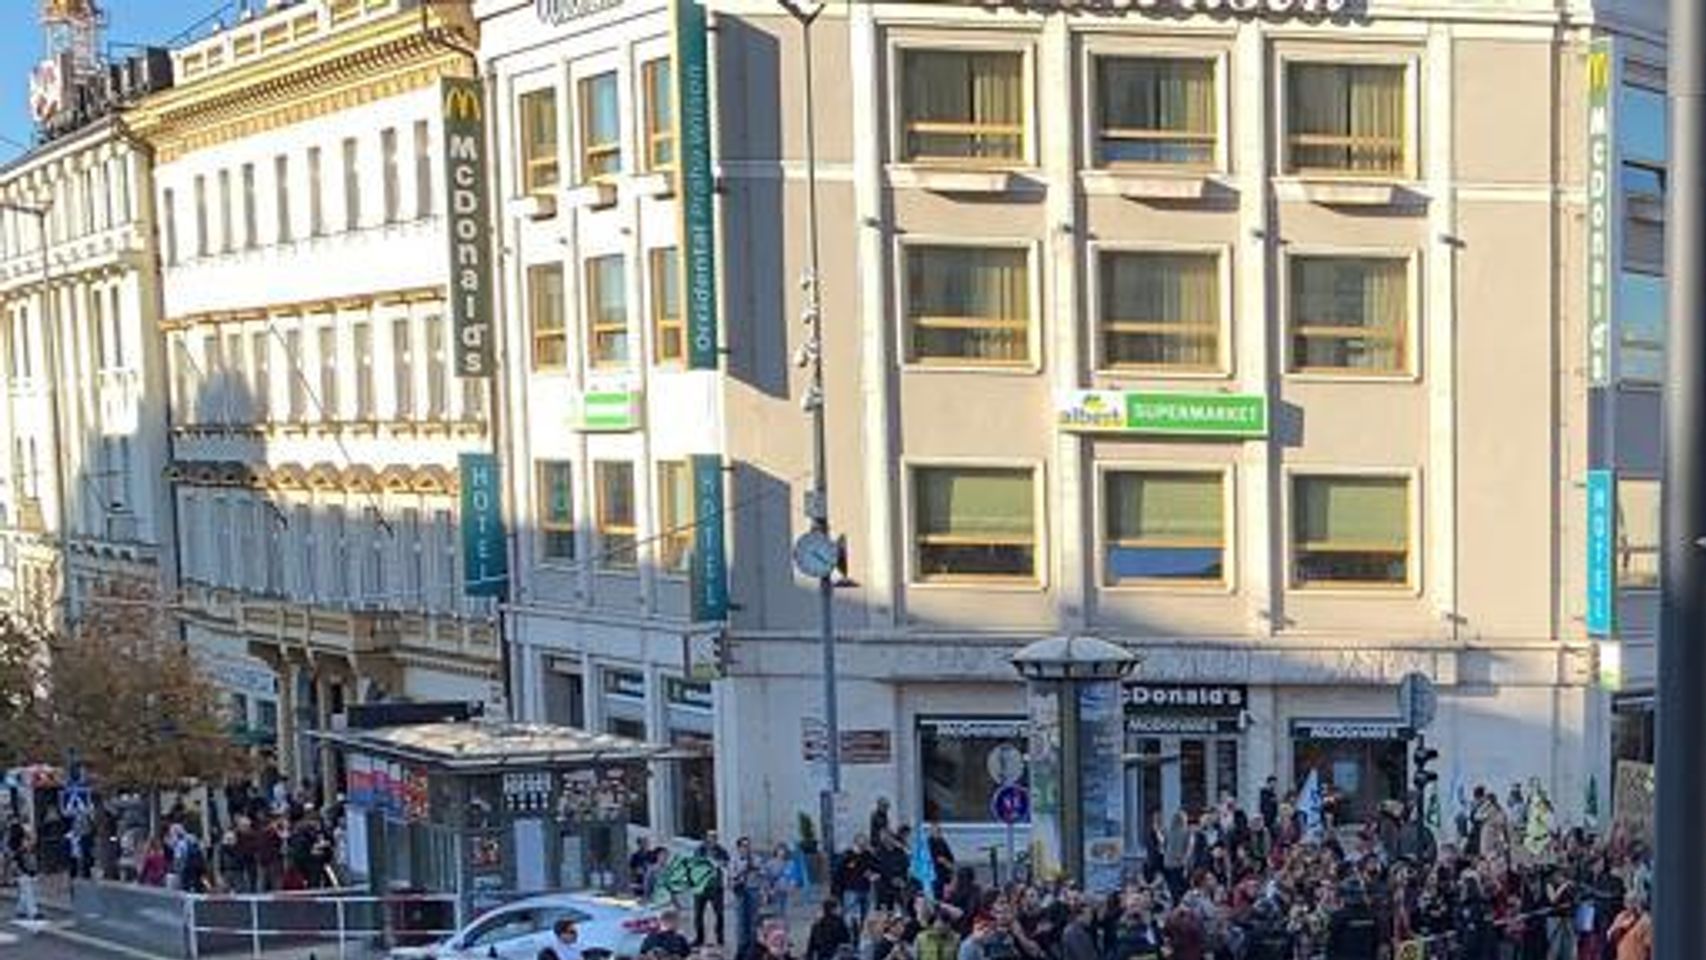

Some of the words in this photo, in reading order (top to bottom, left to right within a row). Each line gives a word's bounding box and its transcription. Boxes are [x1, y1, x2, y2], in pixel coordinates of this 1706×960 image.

[450, 134, 487, 372] McDonald's
[1133, 402, 1256, 422] SUPERMARKET
[472, 466, 491, 580] HOTEL
[1122, 686, 1241, 705] cDonald's
